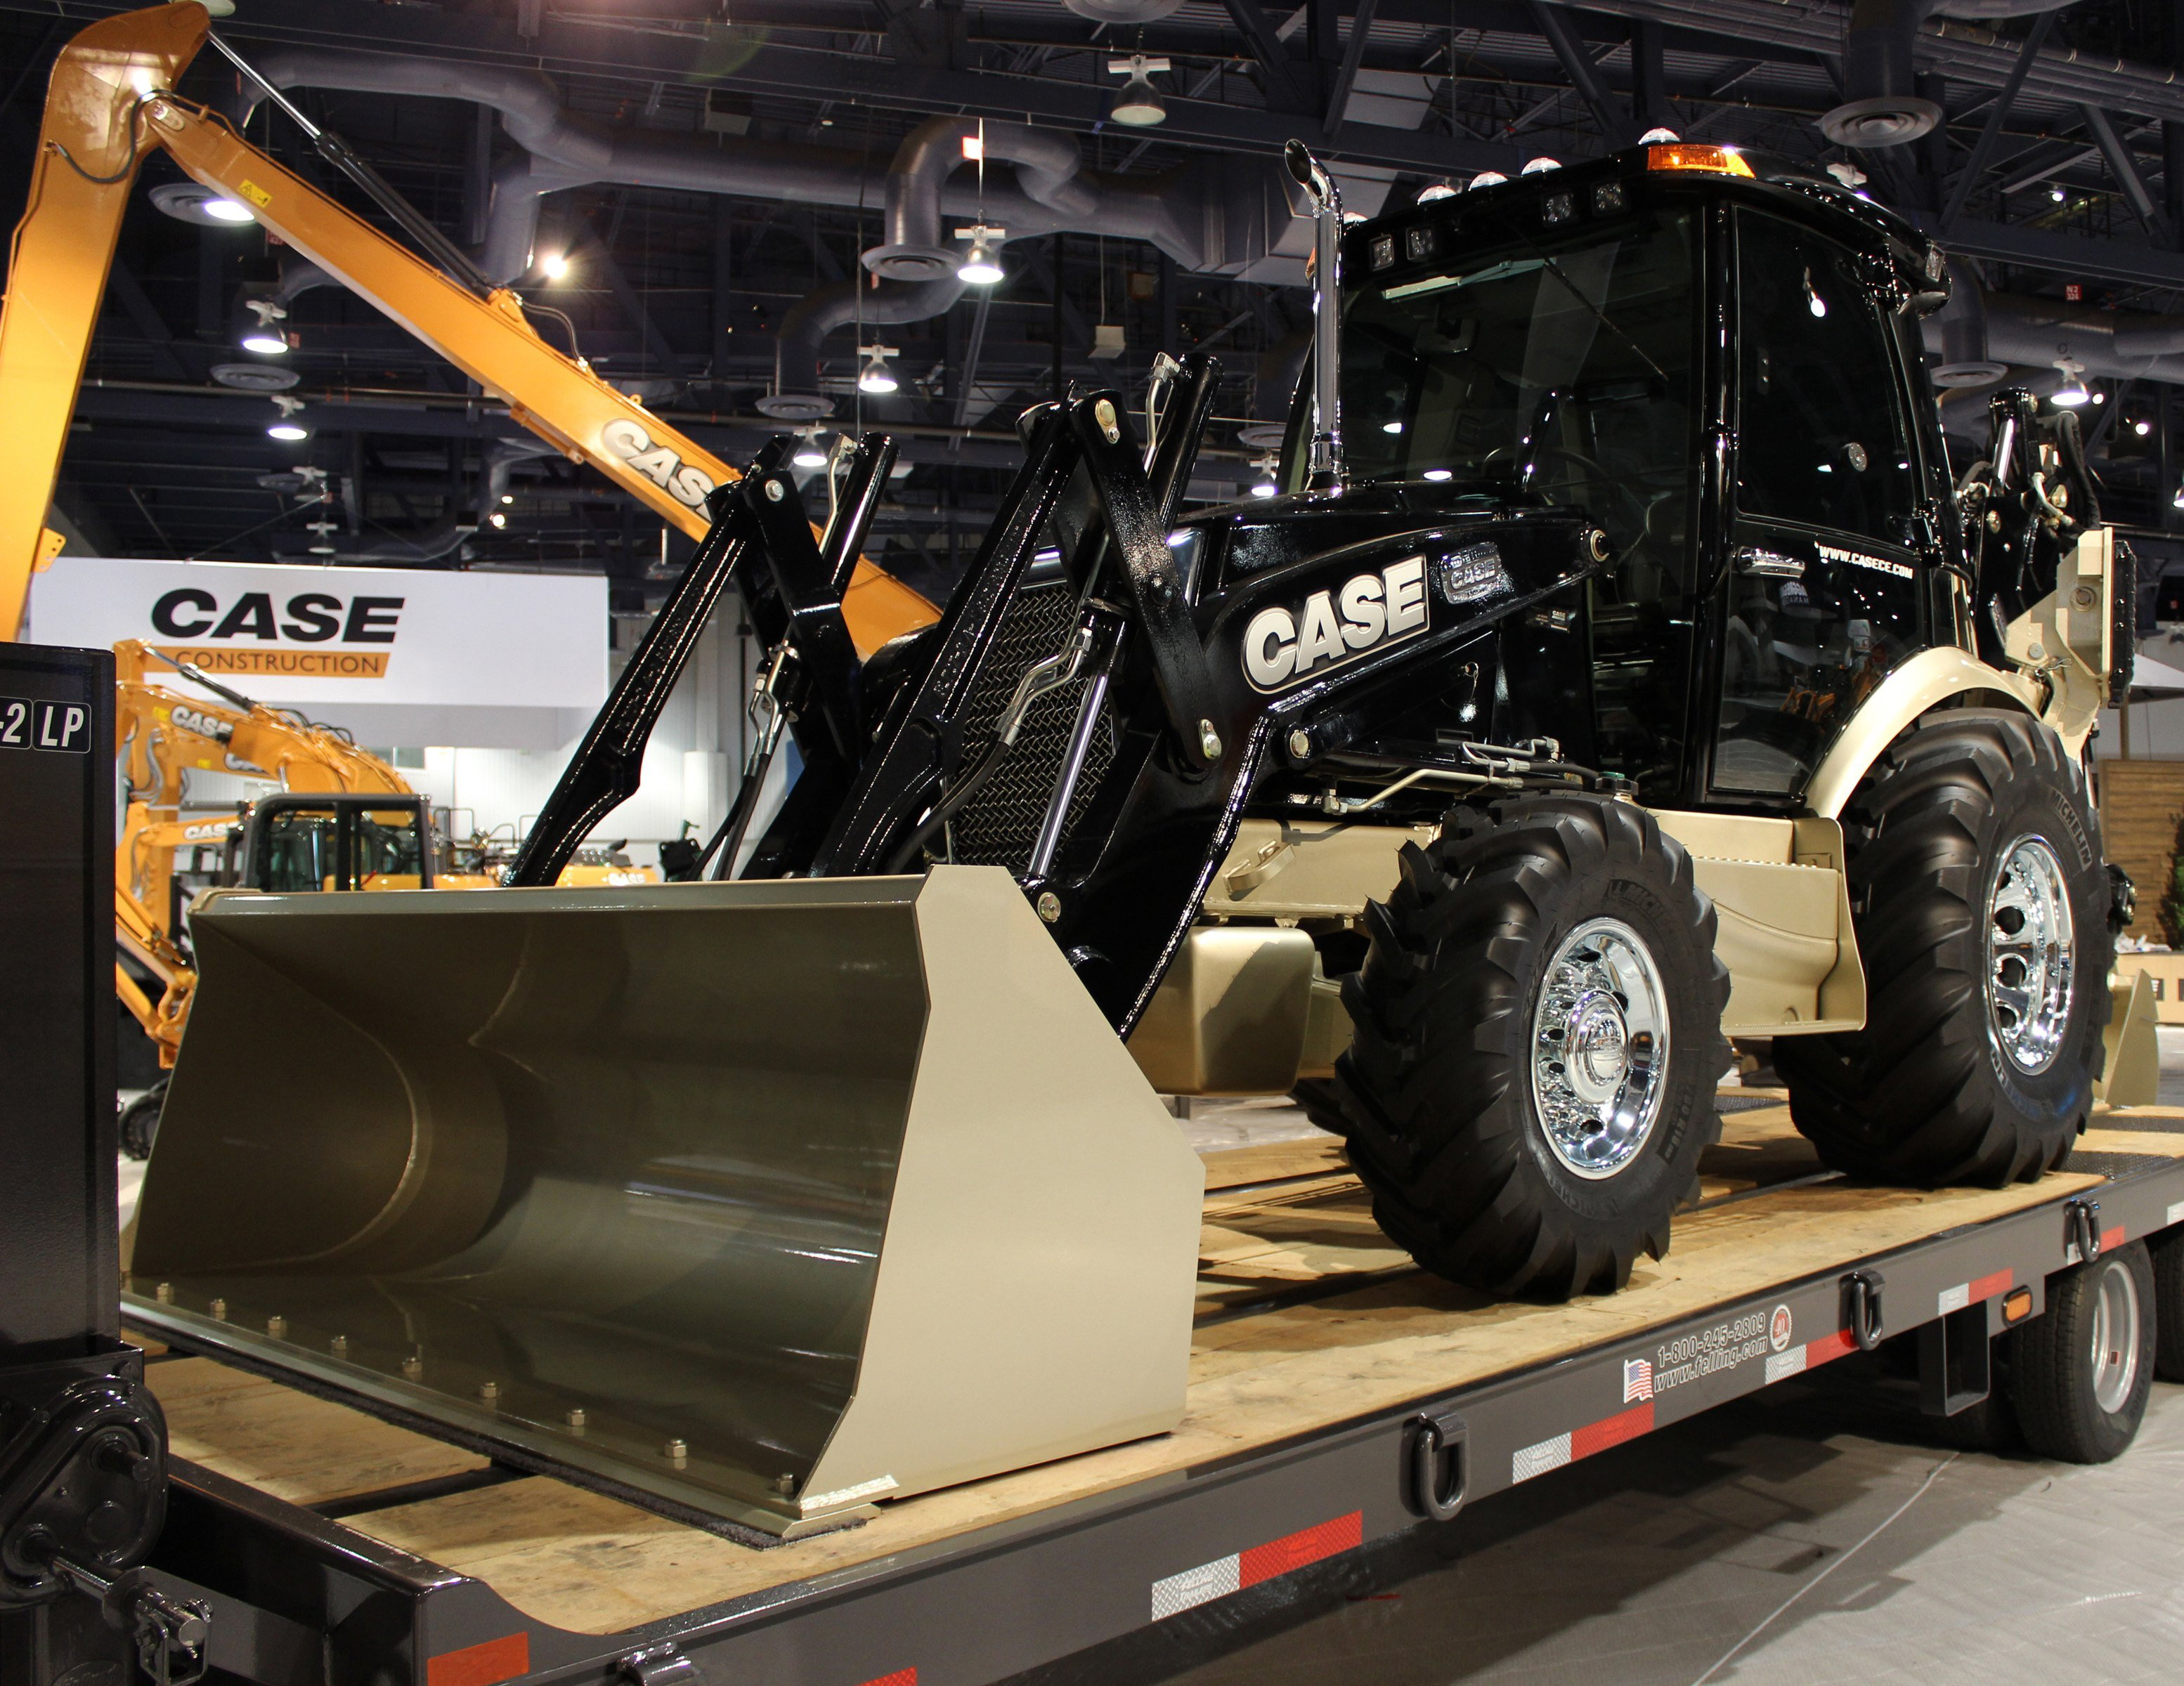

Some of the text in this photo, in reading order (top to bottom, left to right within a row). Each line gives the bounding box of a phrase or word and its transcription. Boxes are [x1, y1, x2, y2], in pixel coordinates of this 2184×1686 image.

[602, 419, 718, 521] CAS
[1451, 558, 1495, 589] CASE
[1819, 545, 1913, 579] WWW.CASECE.COM
[151, 588, 405, 643] CASE
[1245, 555, 1426, 686] CASE
[176, 650, 379, 674] CONSTRUCTION
[40, 705, 84, 747] LP
[183, 821, 240, 839] CAS
[1654, 1335, 1769, 1392] www.felling.com
[1658, 1312, 1766, 1368] 1-800-245-2809
